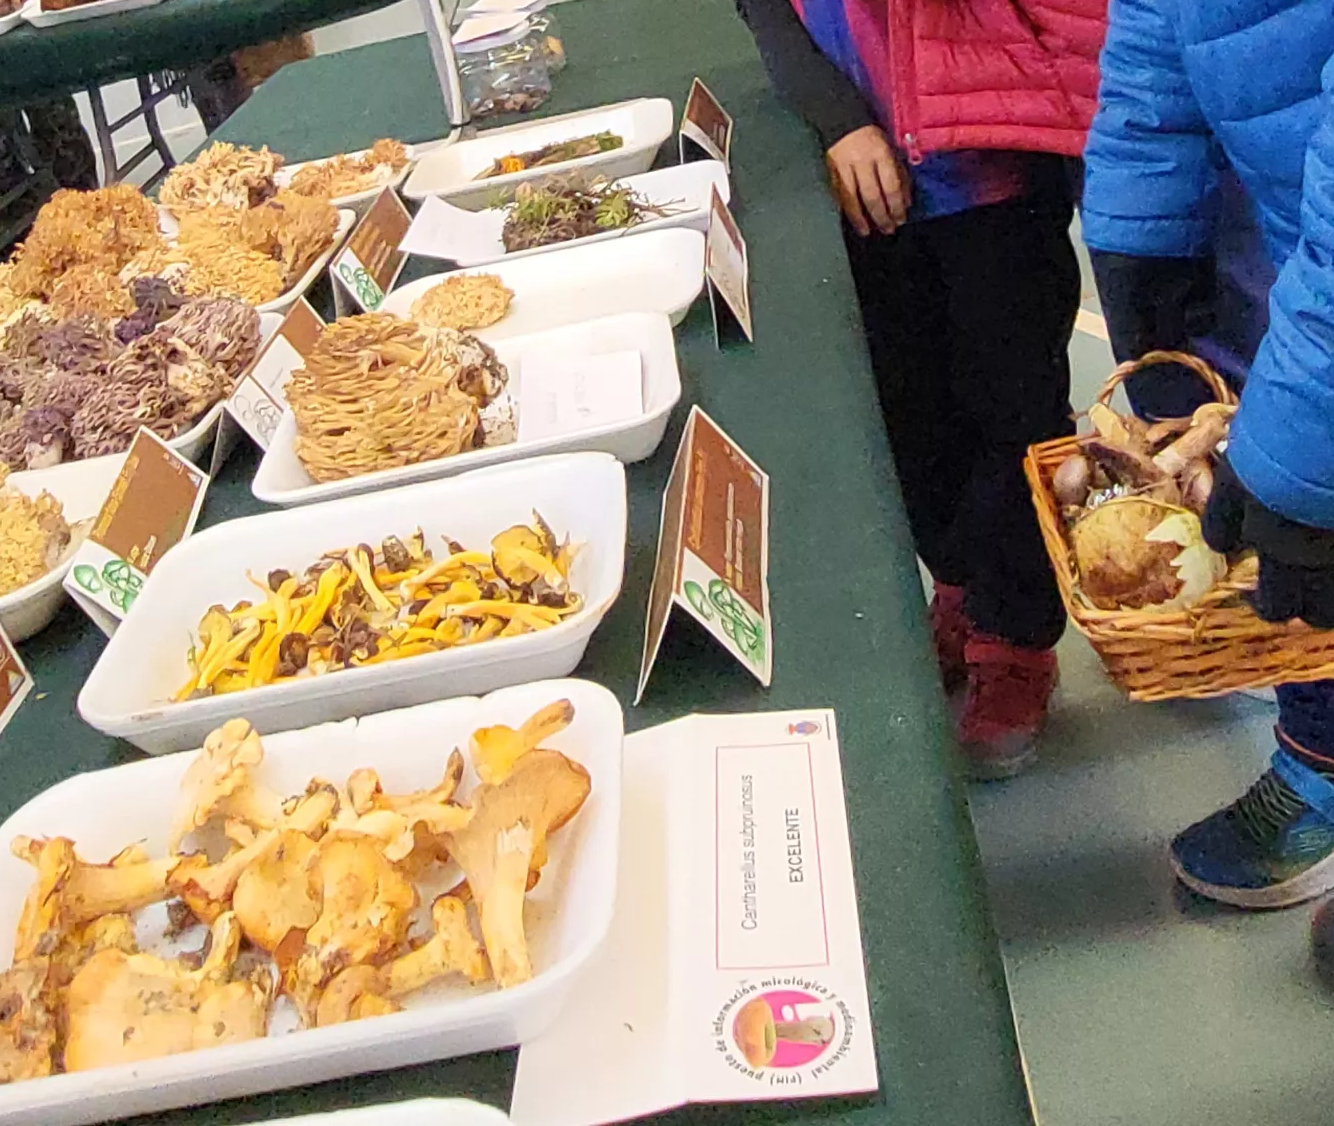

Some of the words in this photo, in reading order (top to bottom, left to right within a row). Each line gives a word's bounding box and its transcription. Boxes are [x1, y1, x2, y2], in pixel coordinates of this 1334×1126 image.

[739, 774, 757, 848] subpruinosus
[785, 807, 804, 883] EXCELENTE
[741, 851, 757, 931] Cantharellus
